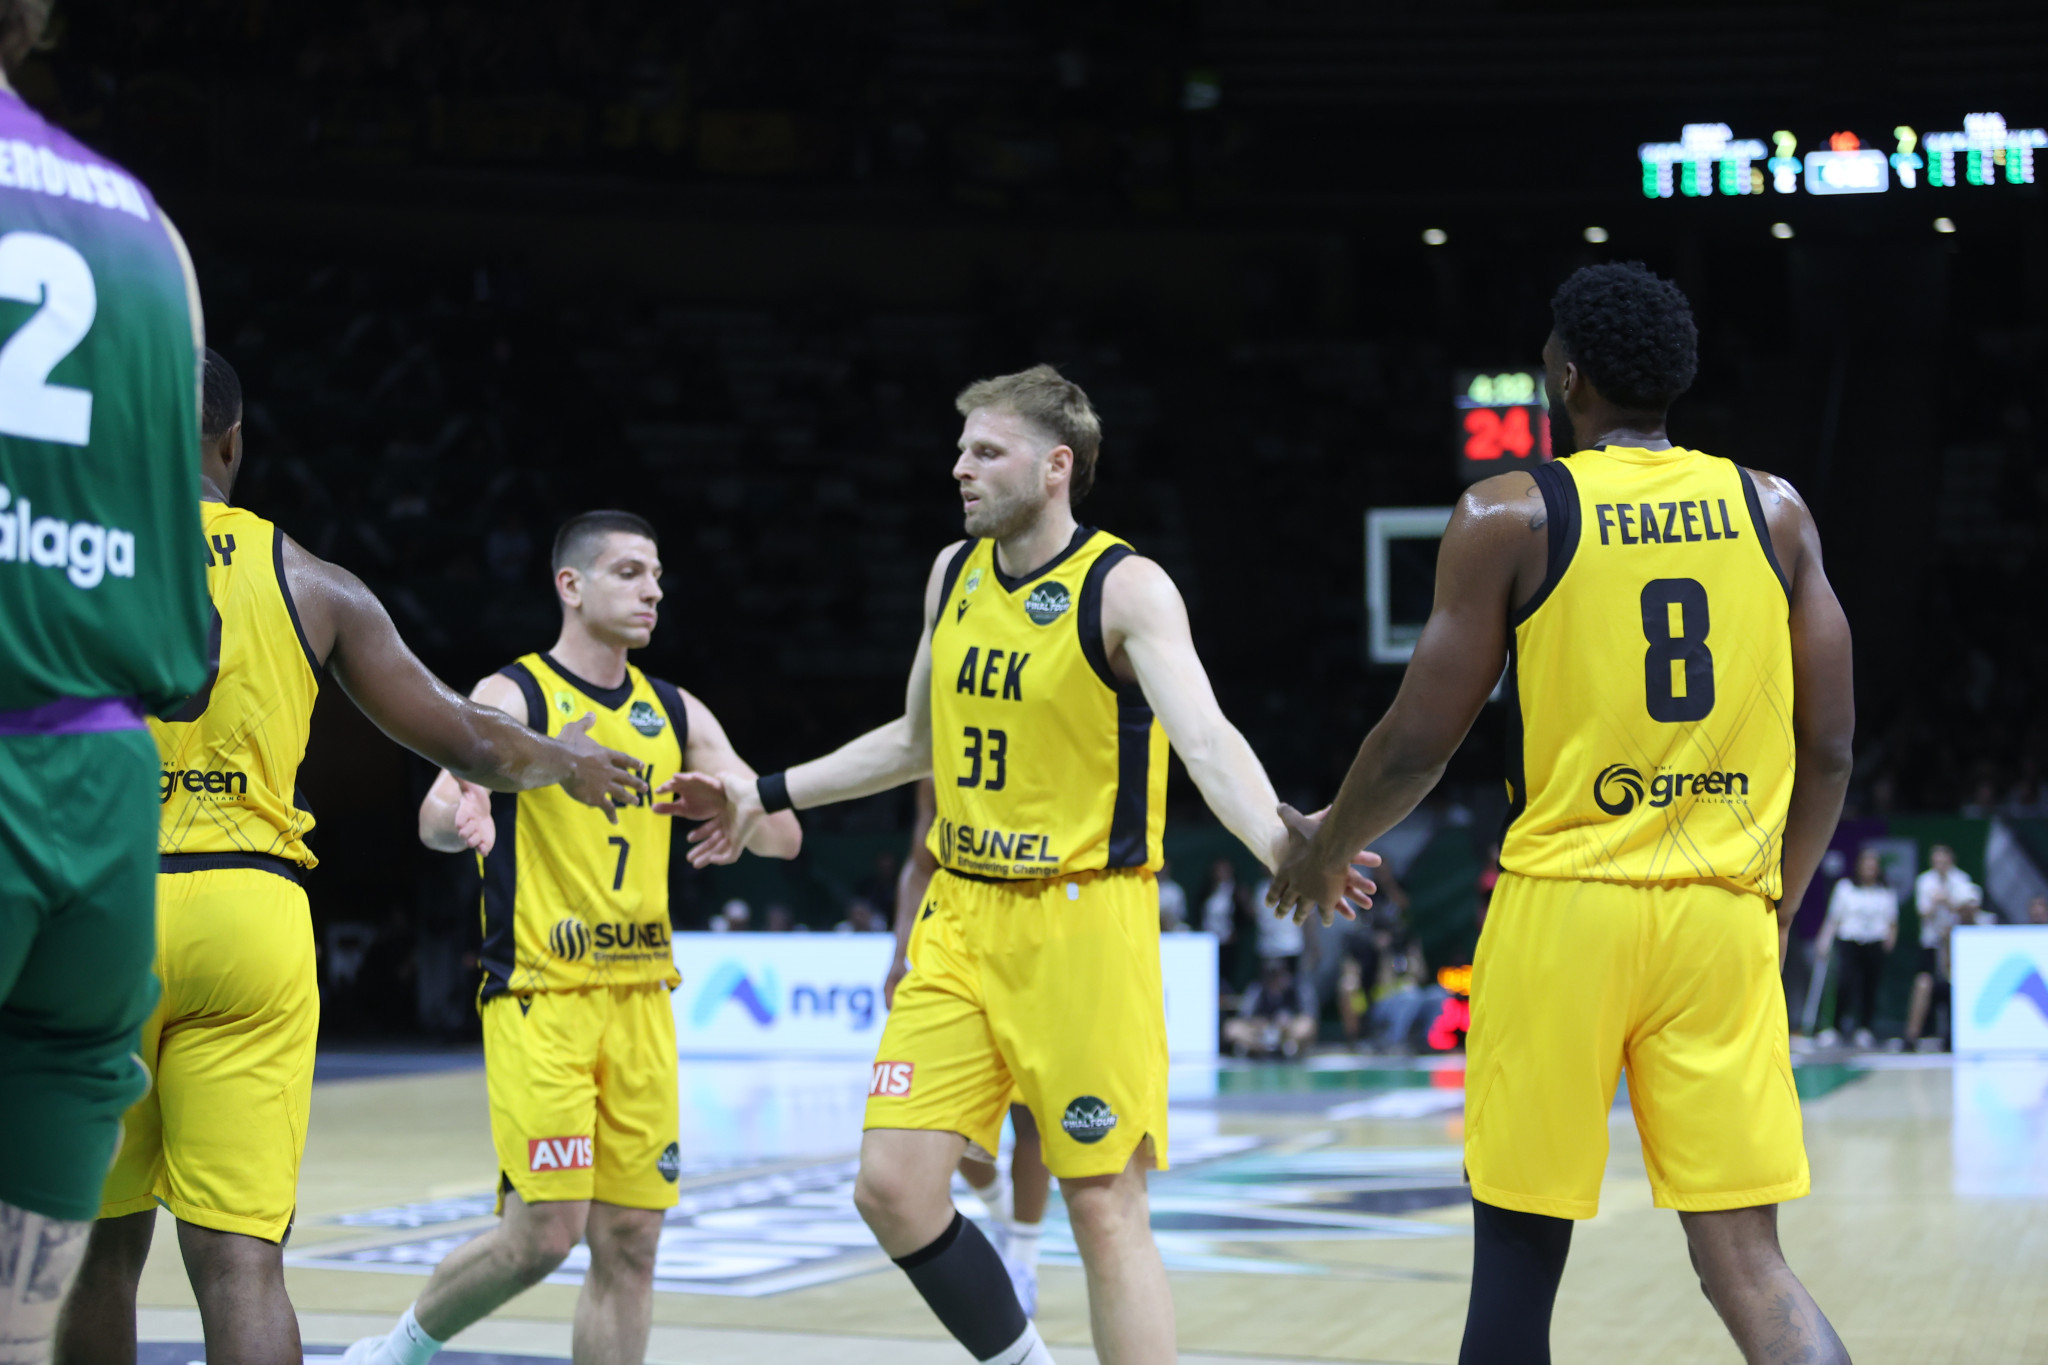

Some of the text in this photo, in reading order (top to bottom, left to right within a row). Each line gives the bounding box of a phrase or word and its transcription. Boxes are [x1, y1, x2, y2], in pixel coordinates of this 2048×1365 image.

[0, 232, 97, 446] 2
[1463, 406, 1535, 460] 24
[1596, 499, 1739, 545] FEAZELL
[1640, 577, 1715, 723] 8
[956, 646, 1031, 702] AEK
[957, 726, 1007, 792] 33
[160, 769, 248, 805] green
[1649, 771, 1749, 808] green
[608, 836, 630, 891] 7
[957, 825, 1060, 862] SUNEL
[1012, 863, 1060, 877] Change
[594, 922, 669, 949] SUNEL
[791, 985, 875, 1031] nrg
[531, 1137, 594, 1171] AVIS
